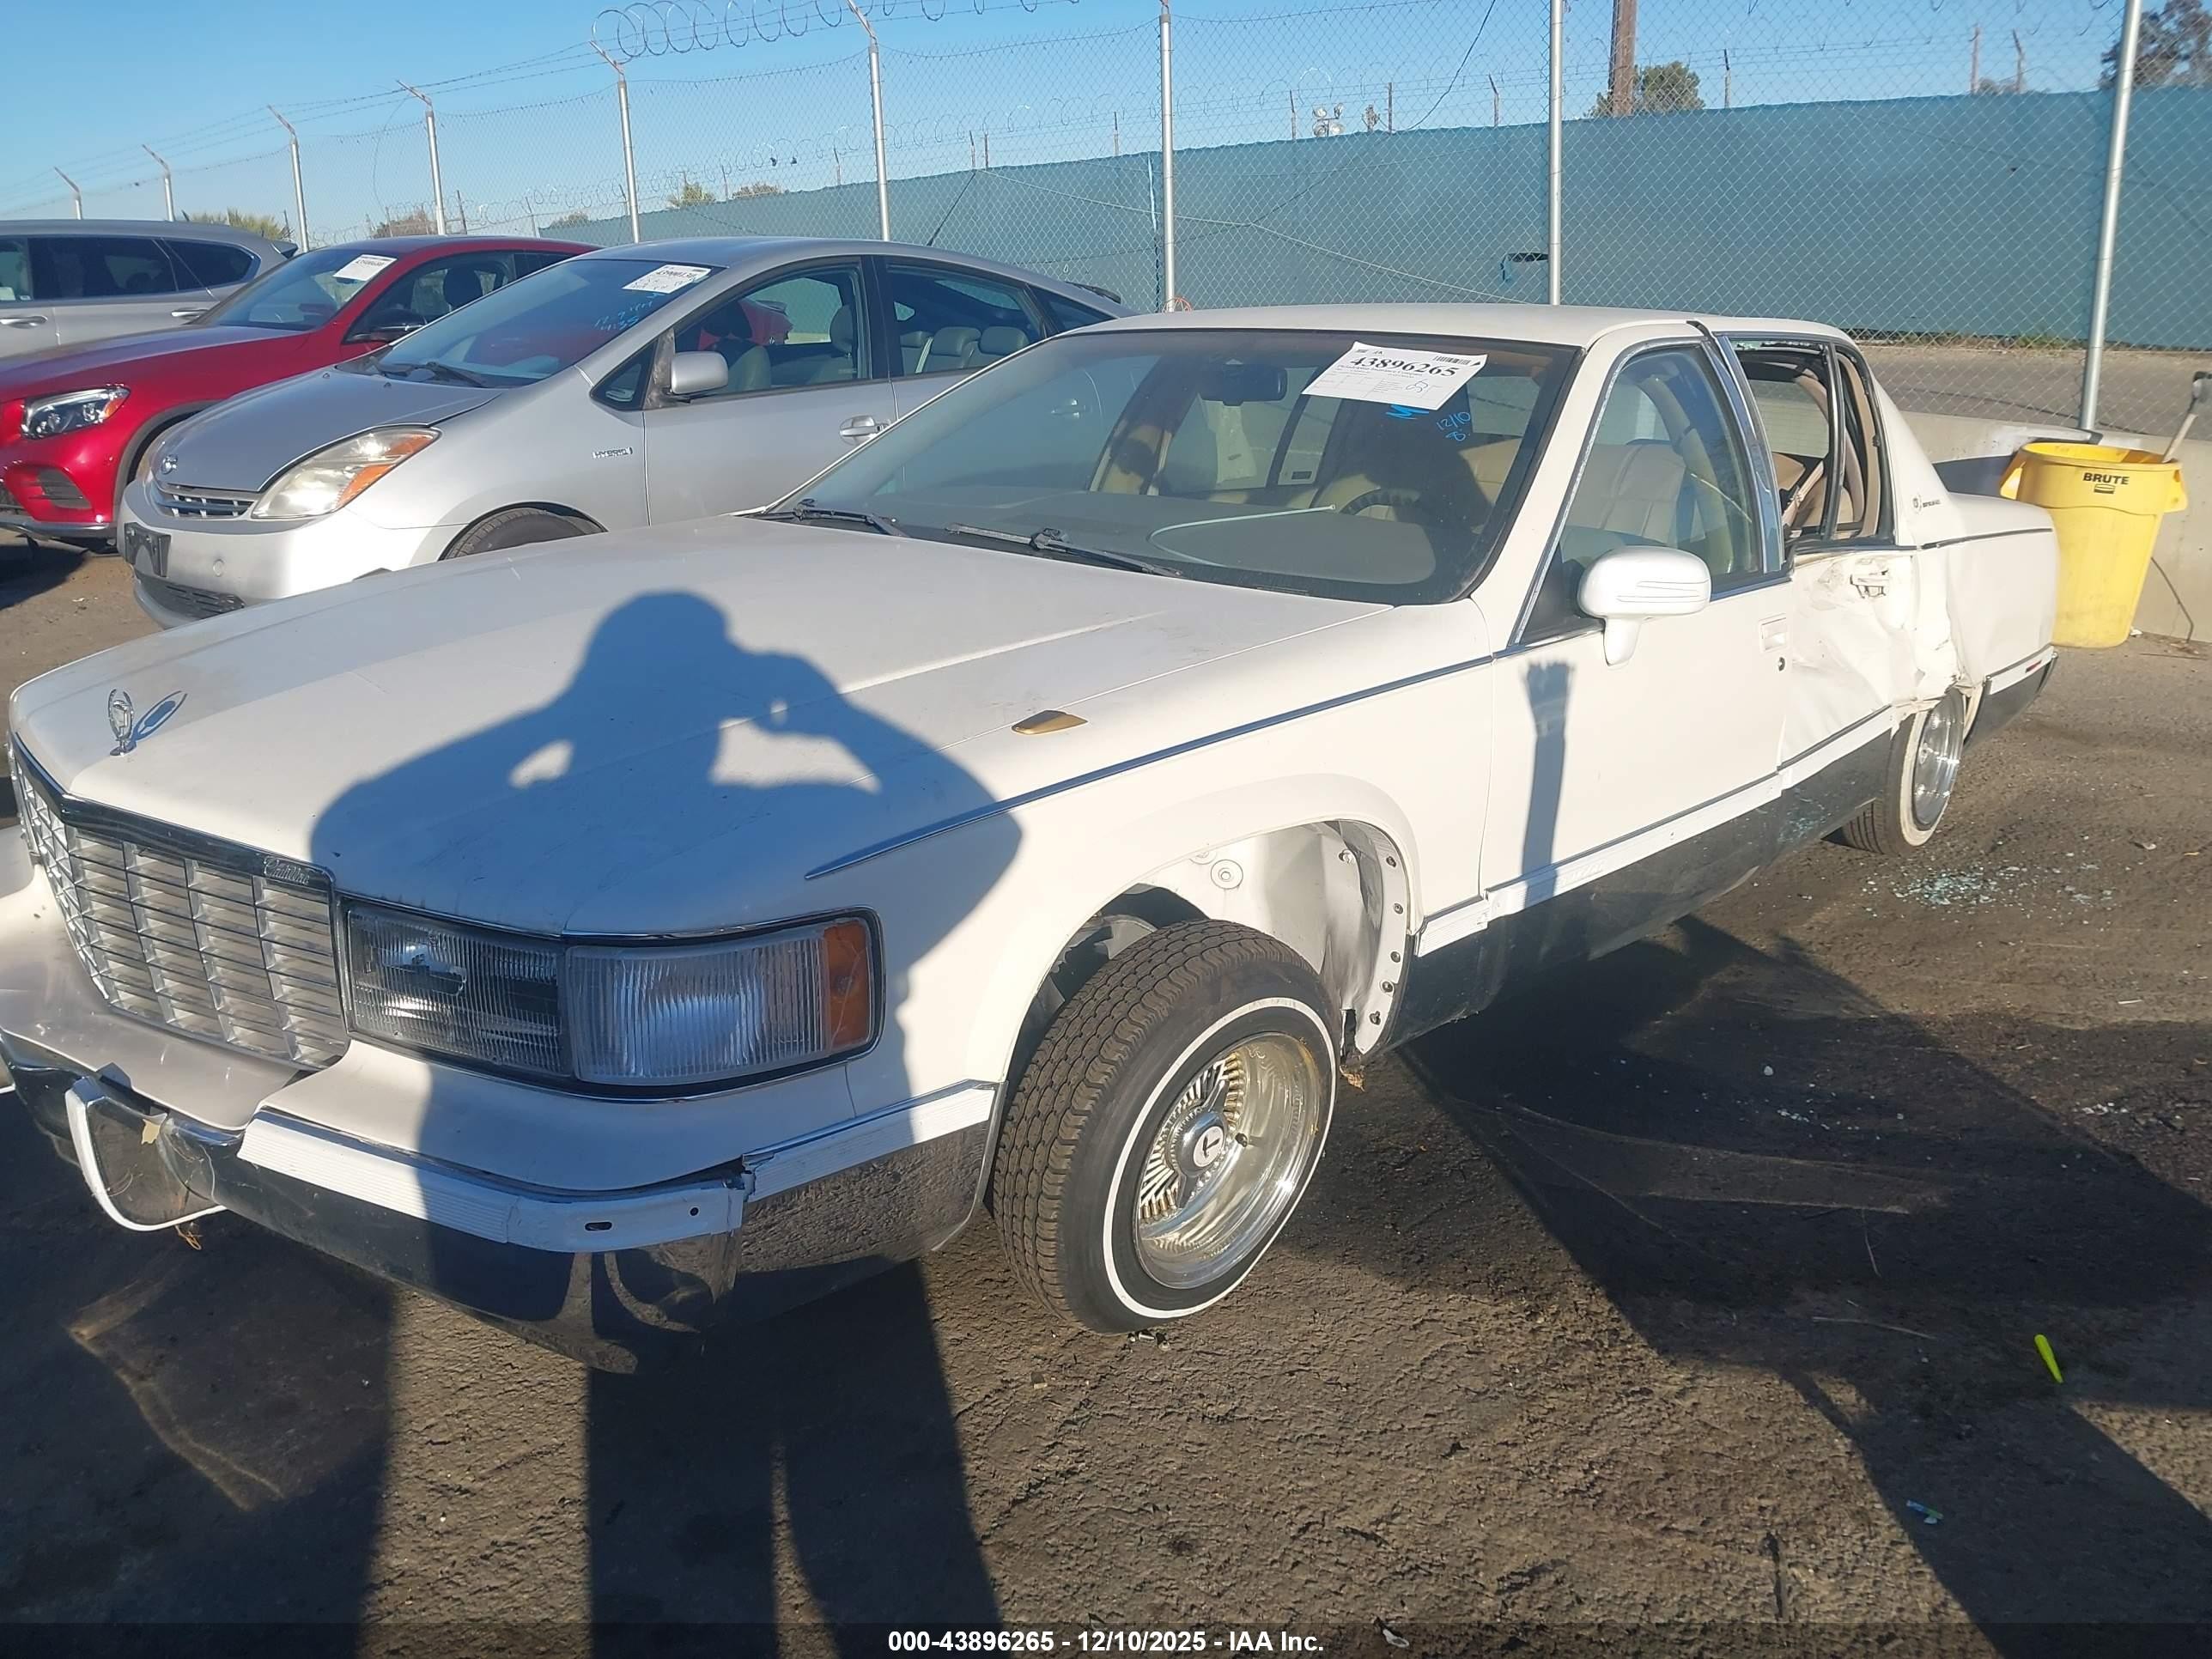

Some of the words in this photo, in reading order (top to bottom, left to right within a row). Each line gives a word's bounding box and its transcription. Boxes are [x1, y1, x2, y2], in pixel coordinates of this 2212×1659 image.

[1350, 356, 1461, 377] 43896265
[1436, 411, 1471, 430] 12/10
[2082, 472, 2130, 484] BRUTE
[263, 855, 310, 885] Cadillac
